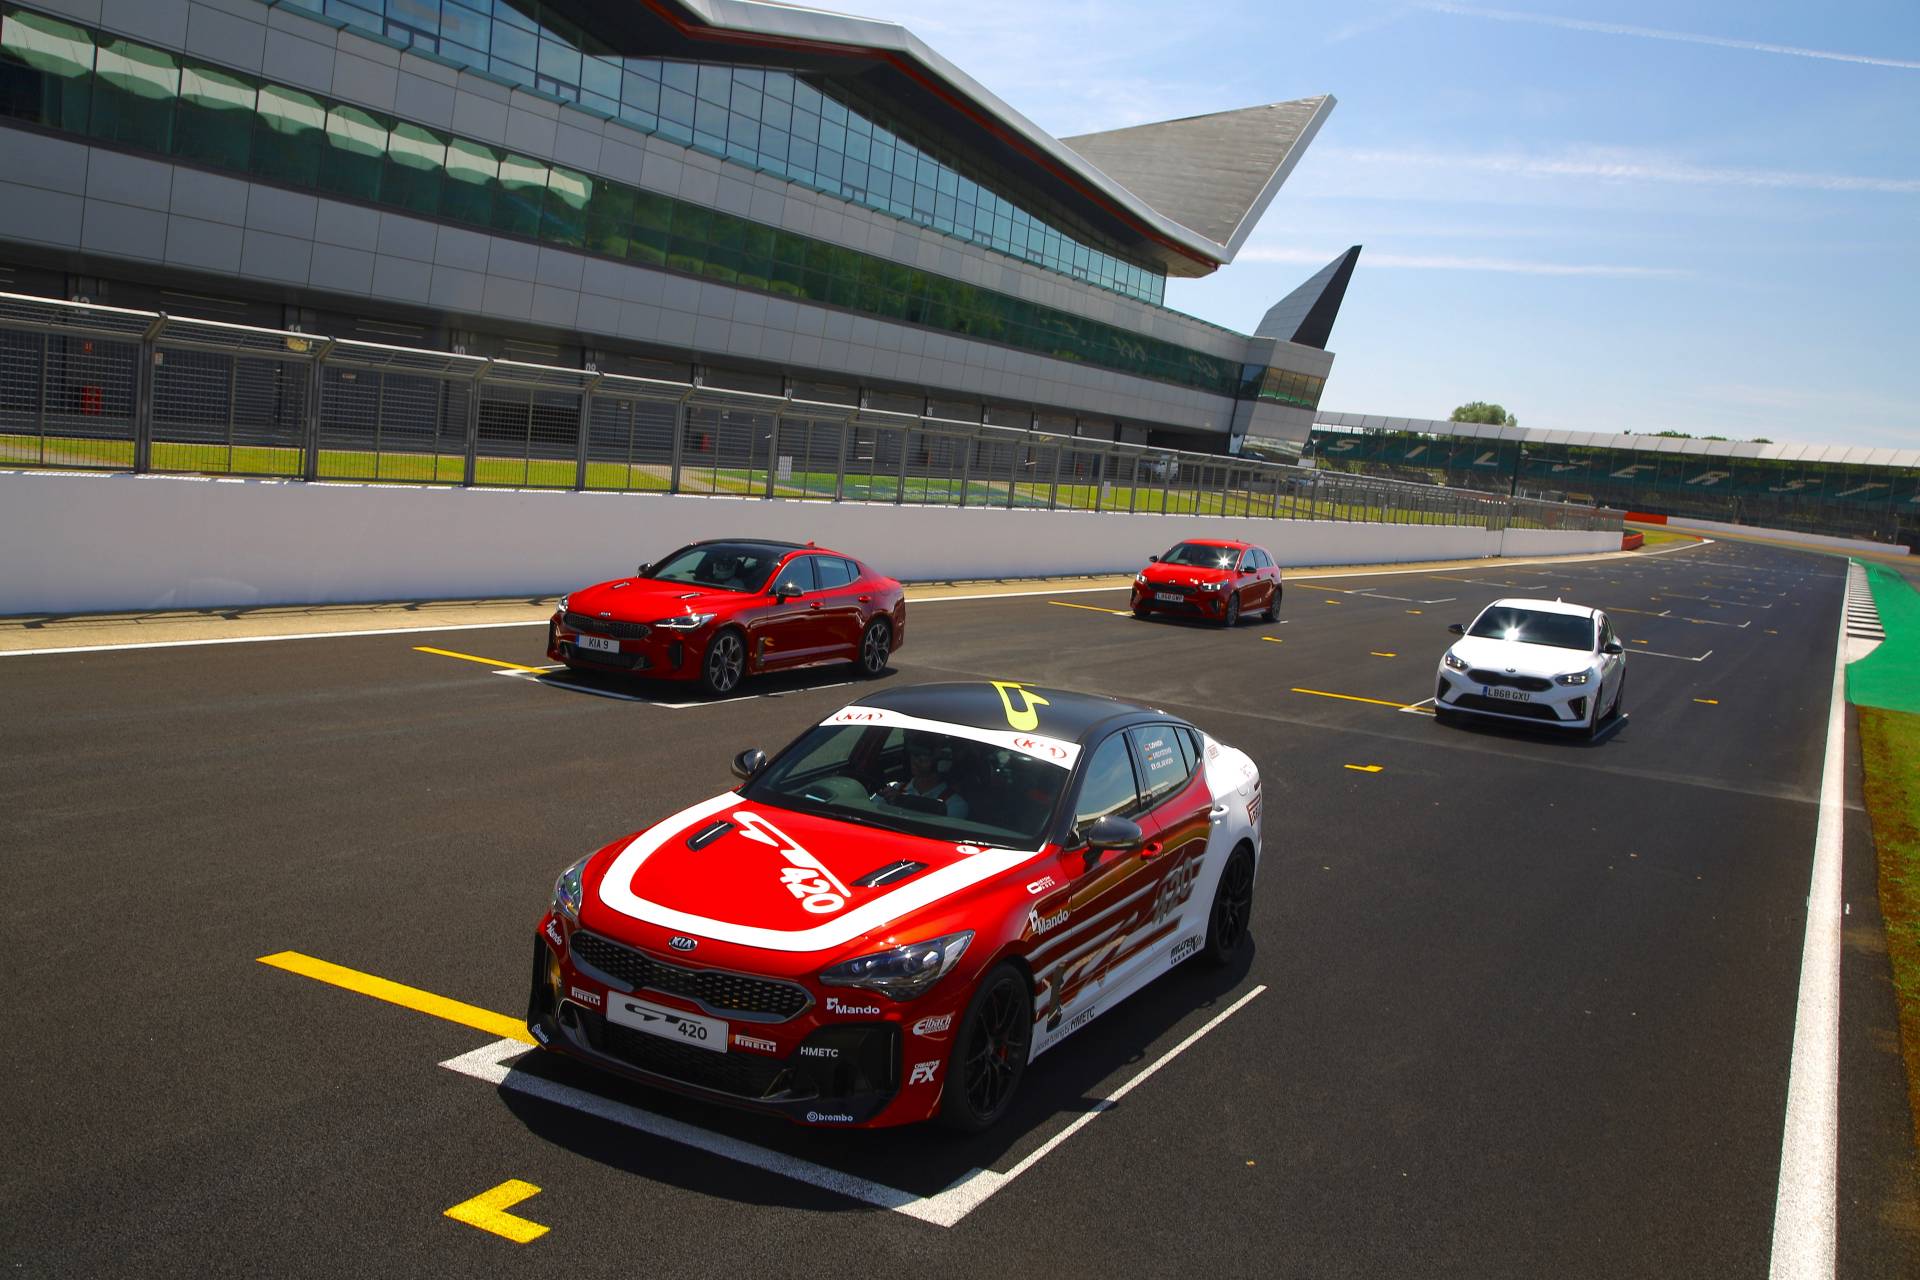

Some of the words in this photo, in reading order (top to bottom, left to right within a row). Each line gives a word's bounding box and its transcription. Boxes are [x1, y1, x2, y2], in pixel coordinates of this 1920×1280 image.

[588, 638, 601, 648] KIA
[603, 640, 609, 649] 9
[1512, 689, 1530, 701] GXU
[780, 868, 845, 914] 420
[1038, 908, 1069, 935] Mando
[671, 936, 692, 949] KIA
[571, 987, 601, 1006] PIRELLI
[835, 1004, 880, 1015] Mando
[1070, 1005, 1096, 1030] HMETC
[678, 1022, 708, 1041] 420
[735, 1034, 777, 1053] PIRELLI
[800, 1046, 839, 1058] HMETC
[909, 1060, 941, 1085] FX
[818, 1113, 854, 1122] brembo
